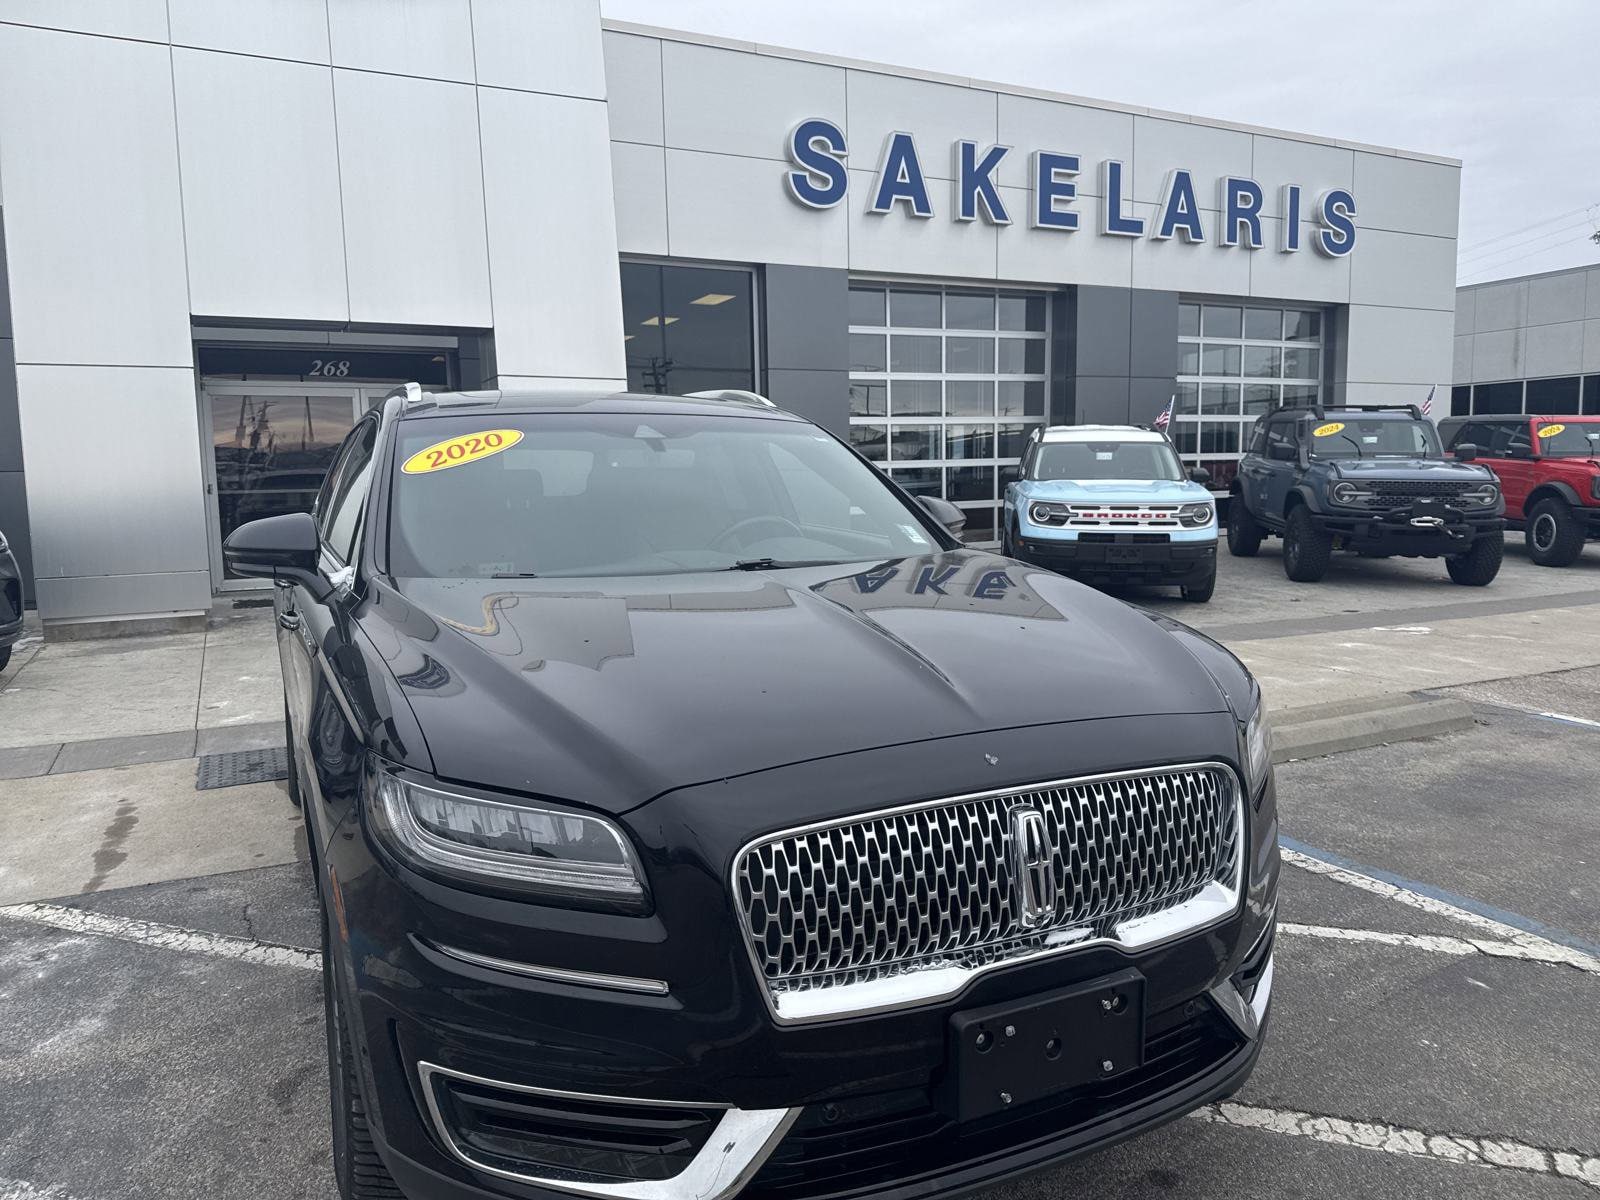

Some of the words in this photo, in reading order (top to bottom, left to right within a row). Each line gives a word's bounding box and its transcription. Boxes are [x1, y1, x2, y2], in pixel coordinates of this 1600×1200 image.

[786, 117, 1358, 259] SAKELARIS
[309, 359, 350, 377] 268
[1317, 424, 1340, 436] 2024
[426, 433, 503, 468] 2020
